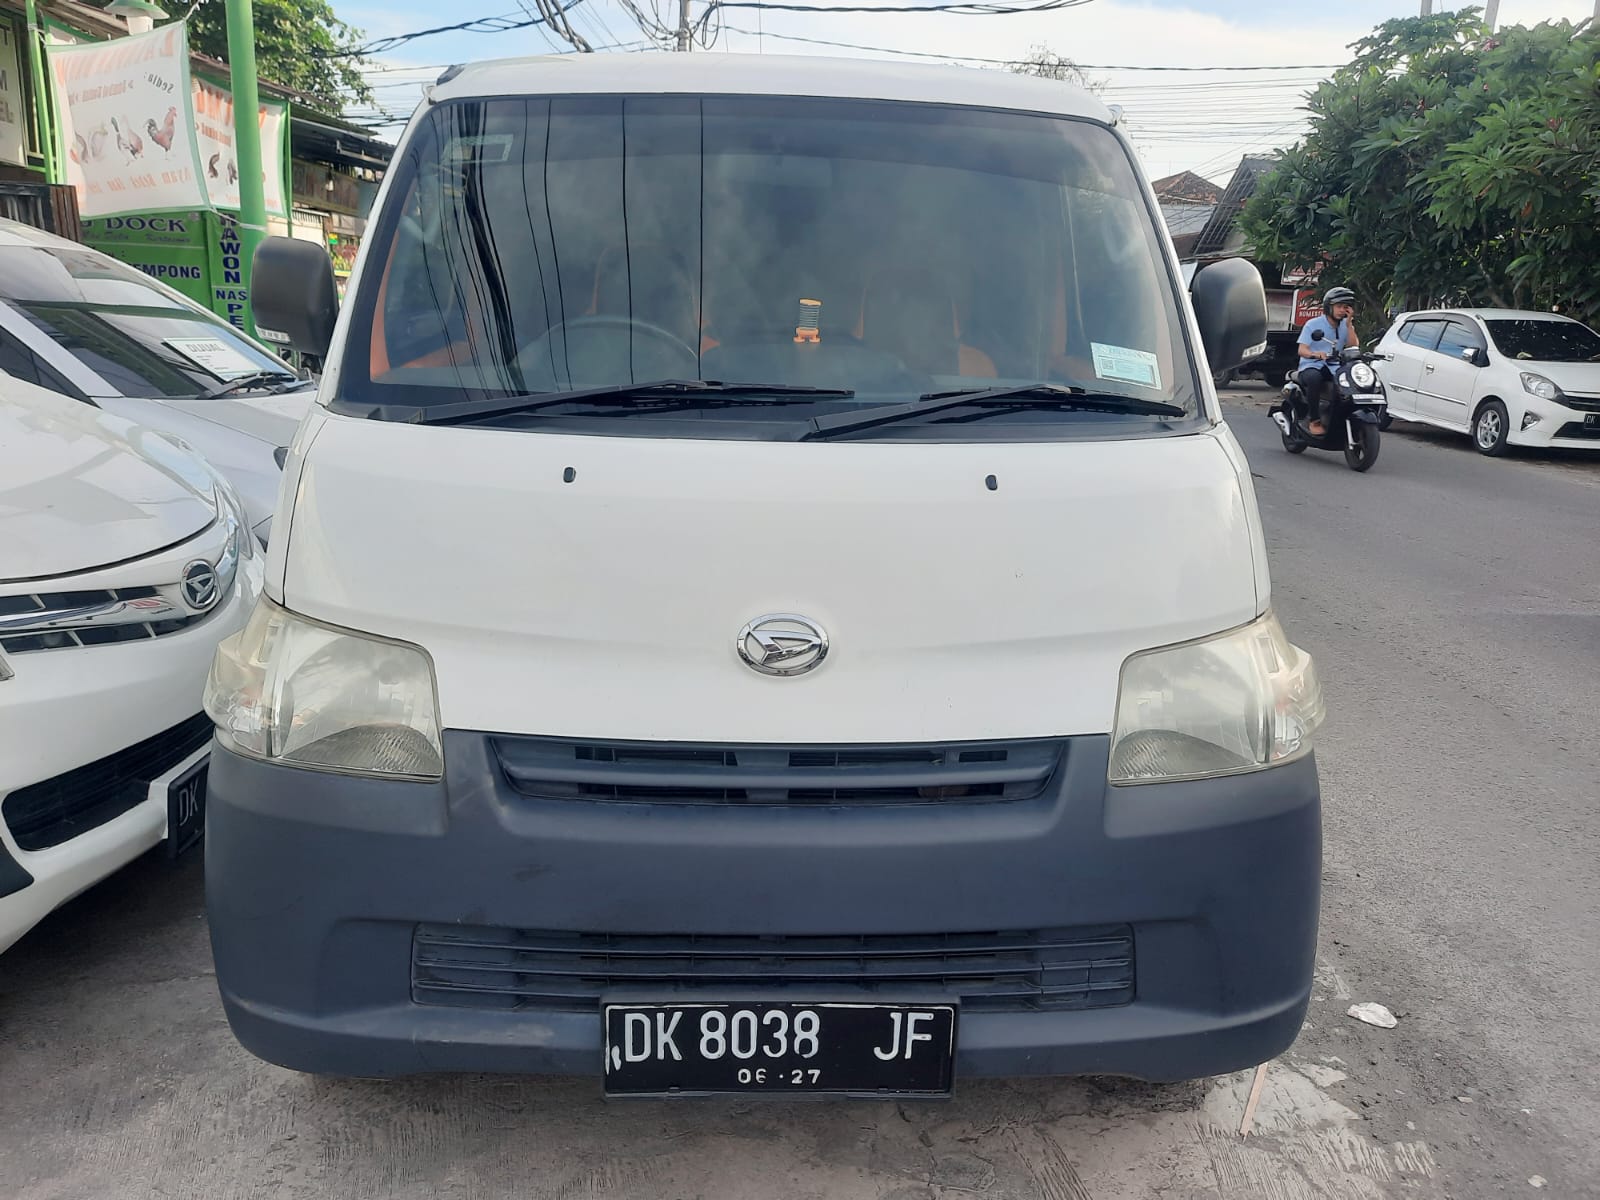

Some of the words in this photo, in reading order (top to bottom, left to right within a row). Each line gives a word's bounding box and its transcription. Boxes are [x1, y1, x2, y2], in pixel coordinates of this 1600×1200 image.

[106, 217, 187, 233] DOCK
[624, 1011, 683, 1062] DK
[700, 1010, 820, 1059] 8038
[873, 1012, 934, 1061] JF
